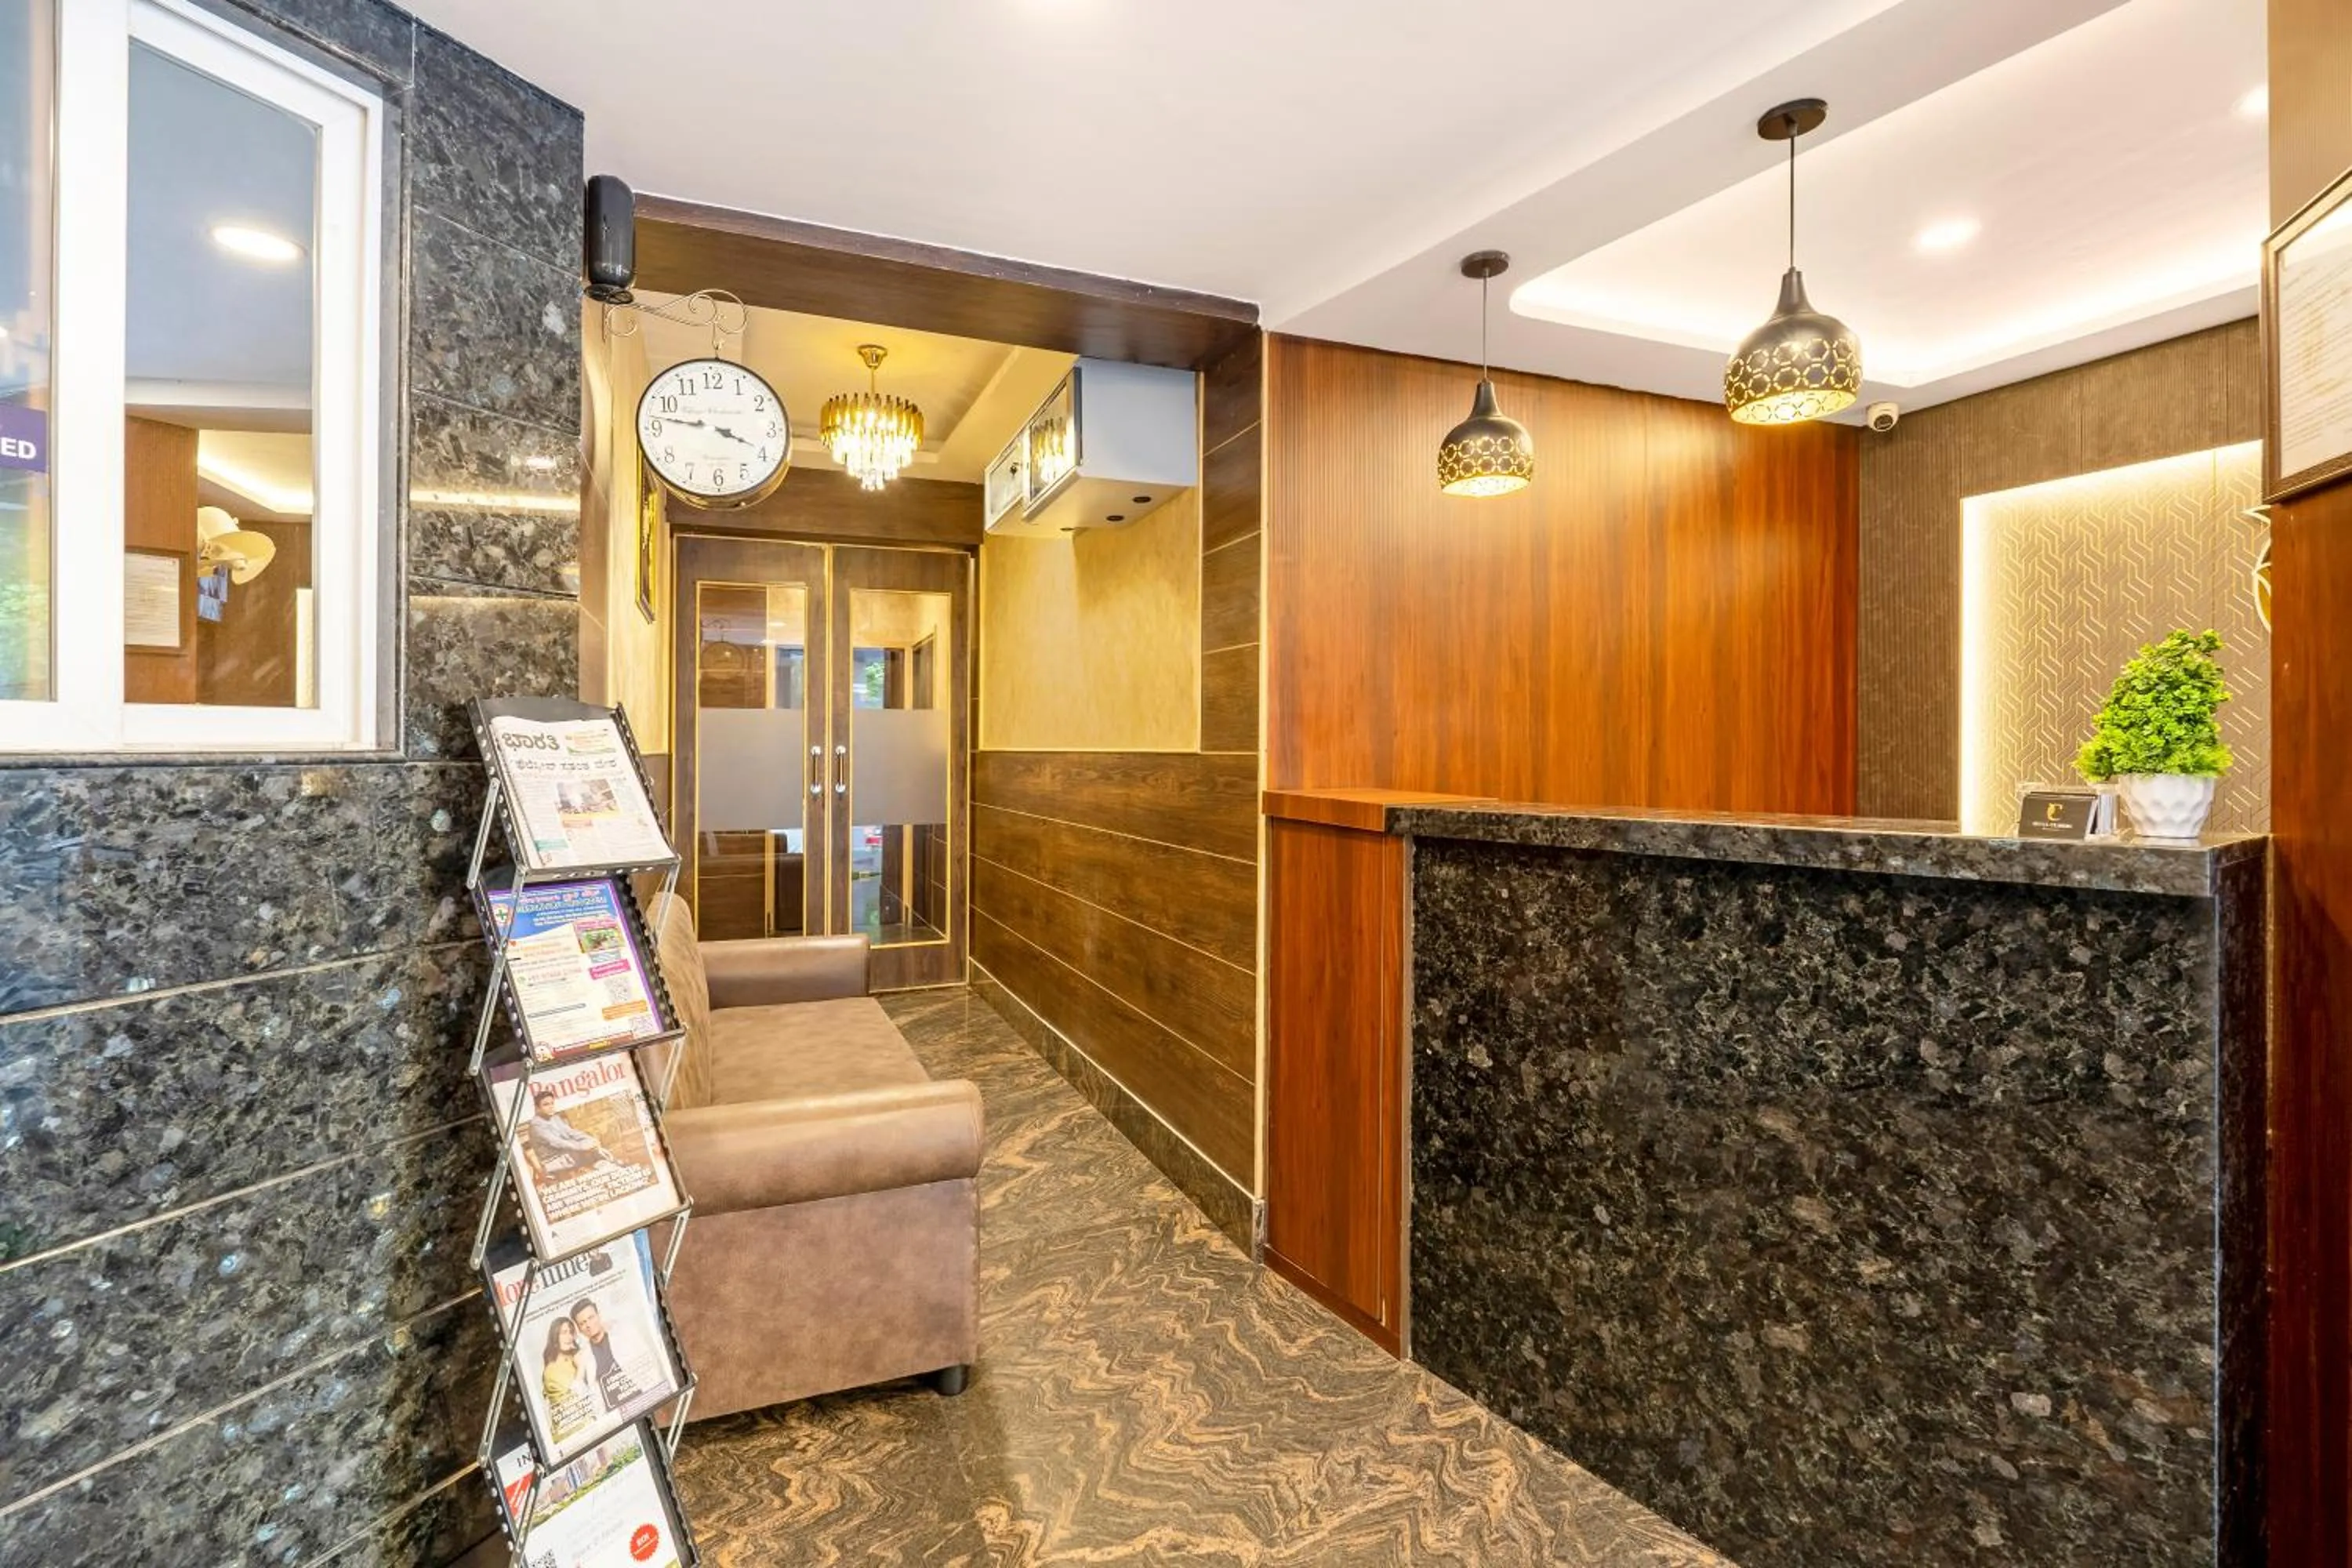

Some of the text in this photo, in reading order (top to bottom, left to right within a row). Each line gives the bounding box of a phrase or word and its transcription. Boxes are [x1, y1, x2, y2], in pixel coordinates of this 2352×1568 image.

[677, 379, 696, 396] 11
[702, 372, 723, 390] 12
[734, 379, 743, 396] 1
[660, 395, 677, 412] 10
[754, 395, 764, 412] 2
[652, 419, 662, 437] 9
[767, 421, 776, 438] 3
[664, 446, 674, 463] 8
[758, 446, 768, 461] 4
[684, 463, 695, 480] 7
[713, 468, 724, 486] 6
[739, 464, 750, 480] 5
